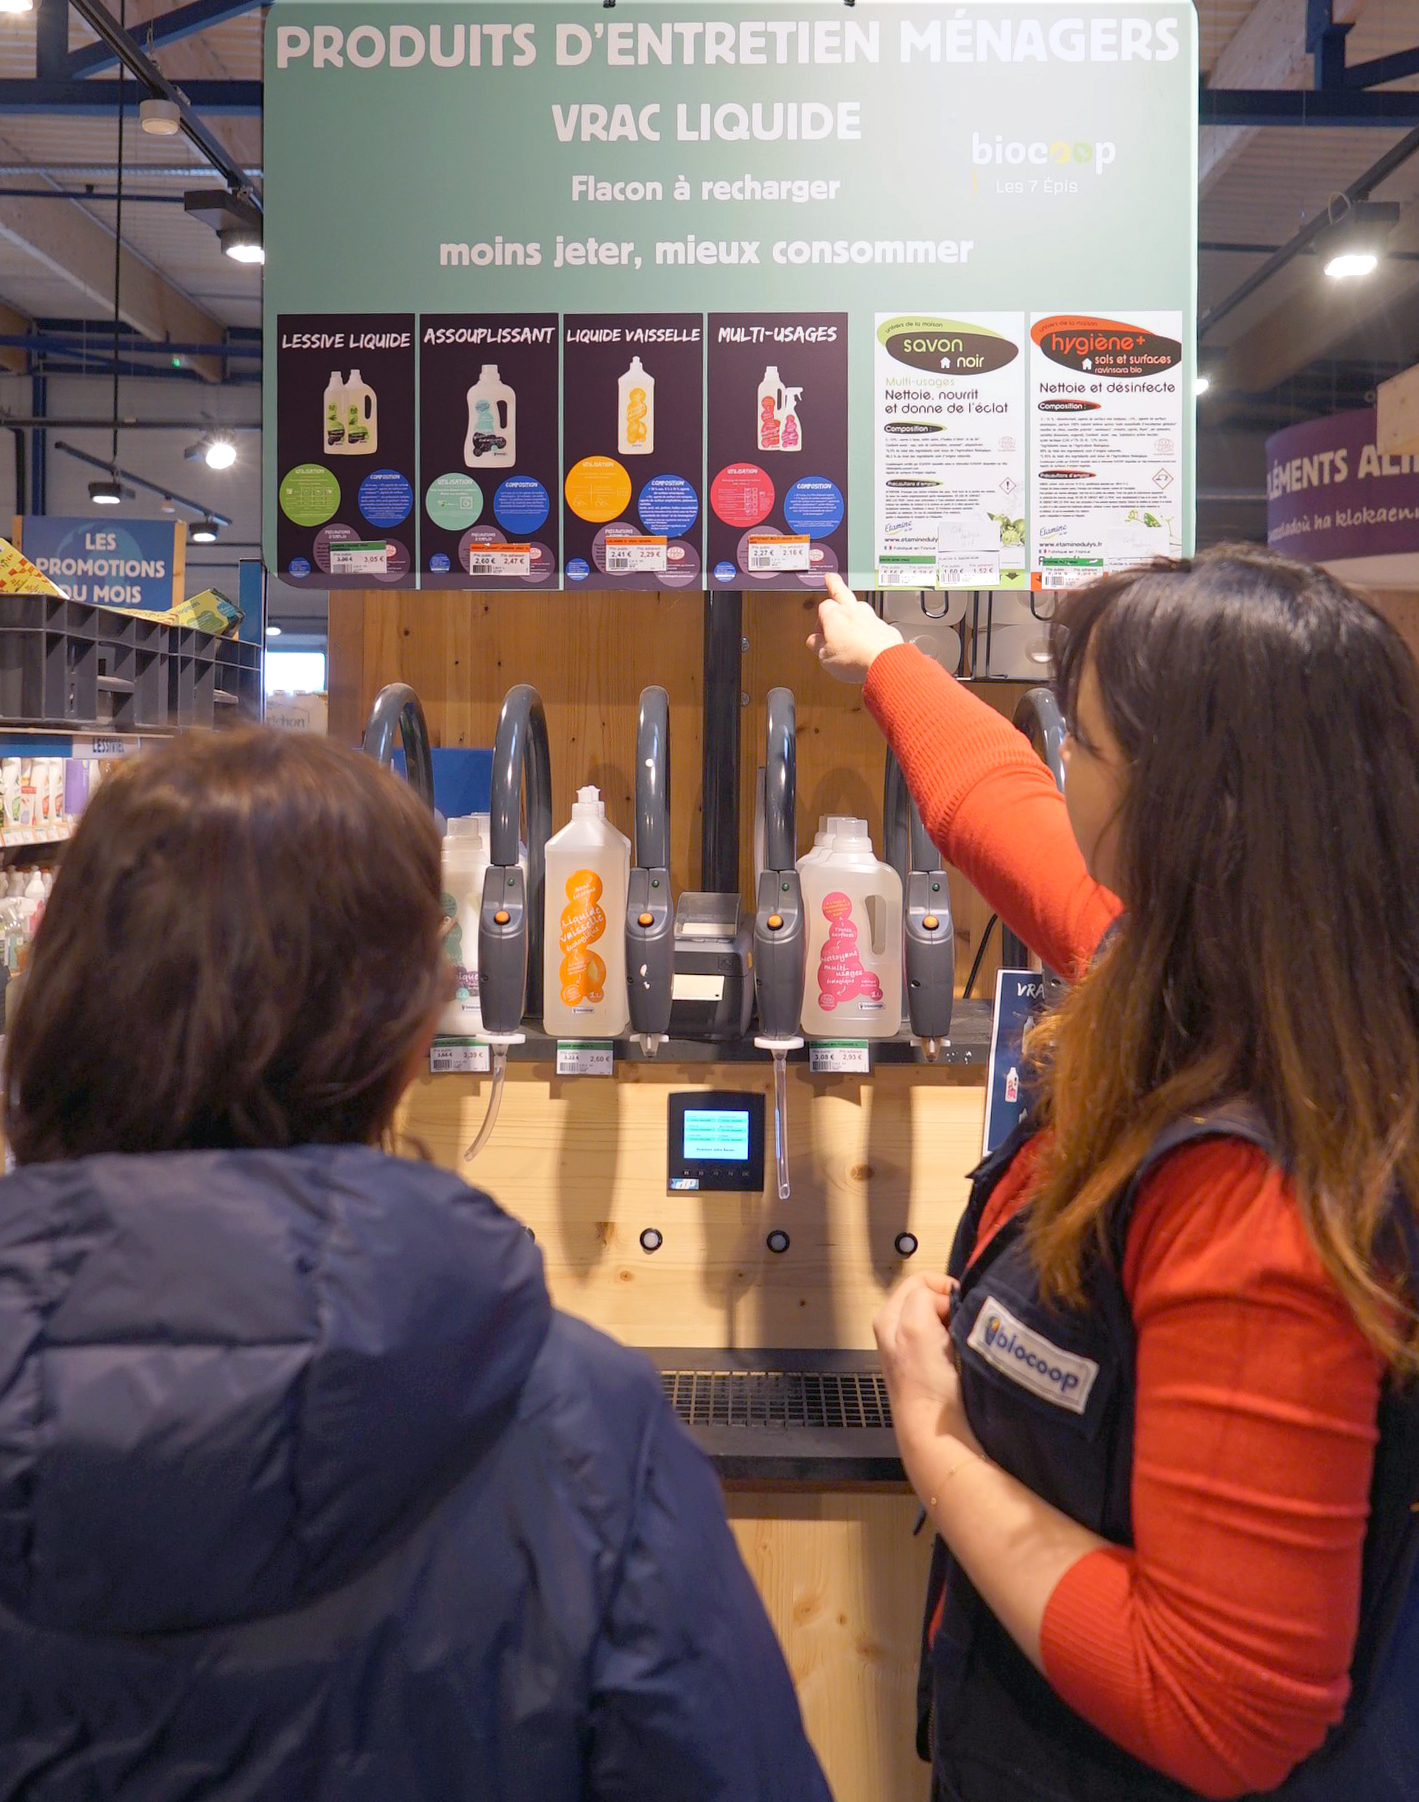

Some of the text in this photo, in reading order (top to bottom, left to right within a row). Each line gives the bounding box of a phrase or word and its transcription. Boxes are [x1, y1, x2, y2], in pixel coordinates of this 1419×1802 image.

[276, 23, 537, 69] PRODUITS
[900, 8, 1179, 63] MÉNAGERS
[551, 101, 862, 142] VRAC LIQUIDE
[972, 131, 1116, 175] biocoop
[571, 174, 840, 203] Flacon à recharger
[996, 176, 1078, 196] Les 7 Épis
[439, 234, 974, 270] moins jeter, mieux consommer
[282, 332, 411, 349] LESSIVE LIQUIDE
[423, 326, 556, 344] ASSOUPLISSANT
[566, 328, 701, 343] LIQUIDE VAISSELLE
[717, 326, 838, 343] MULTI-USAGES
[903, 338, 964, 353] savon
[956, 353, 985, 368] noir
[1094, 353, 1172, 365] sols et surfaces
[1094, 365, 1143, 374] ravinsara bio
[885, 376, 956, 389] Multi-usages
[1039, 382, 1176, 394] Nettoie et désinfecte
[885, 388, 979, 401] Nettoie, nourrit
[884, 402, 1009, 414] et donne de l'éclat
[85, 532, 117, 551] LES
[35, 557, 166, 579] PROMOTIONS
[93, 585, 142, 604] MOIS
[1017, 982, 1045, 1000] VRA
[996, 1326, 1079, 1393] biocoop
